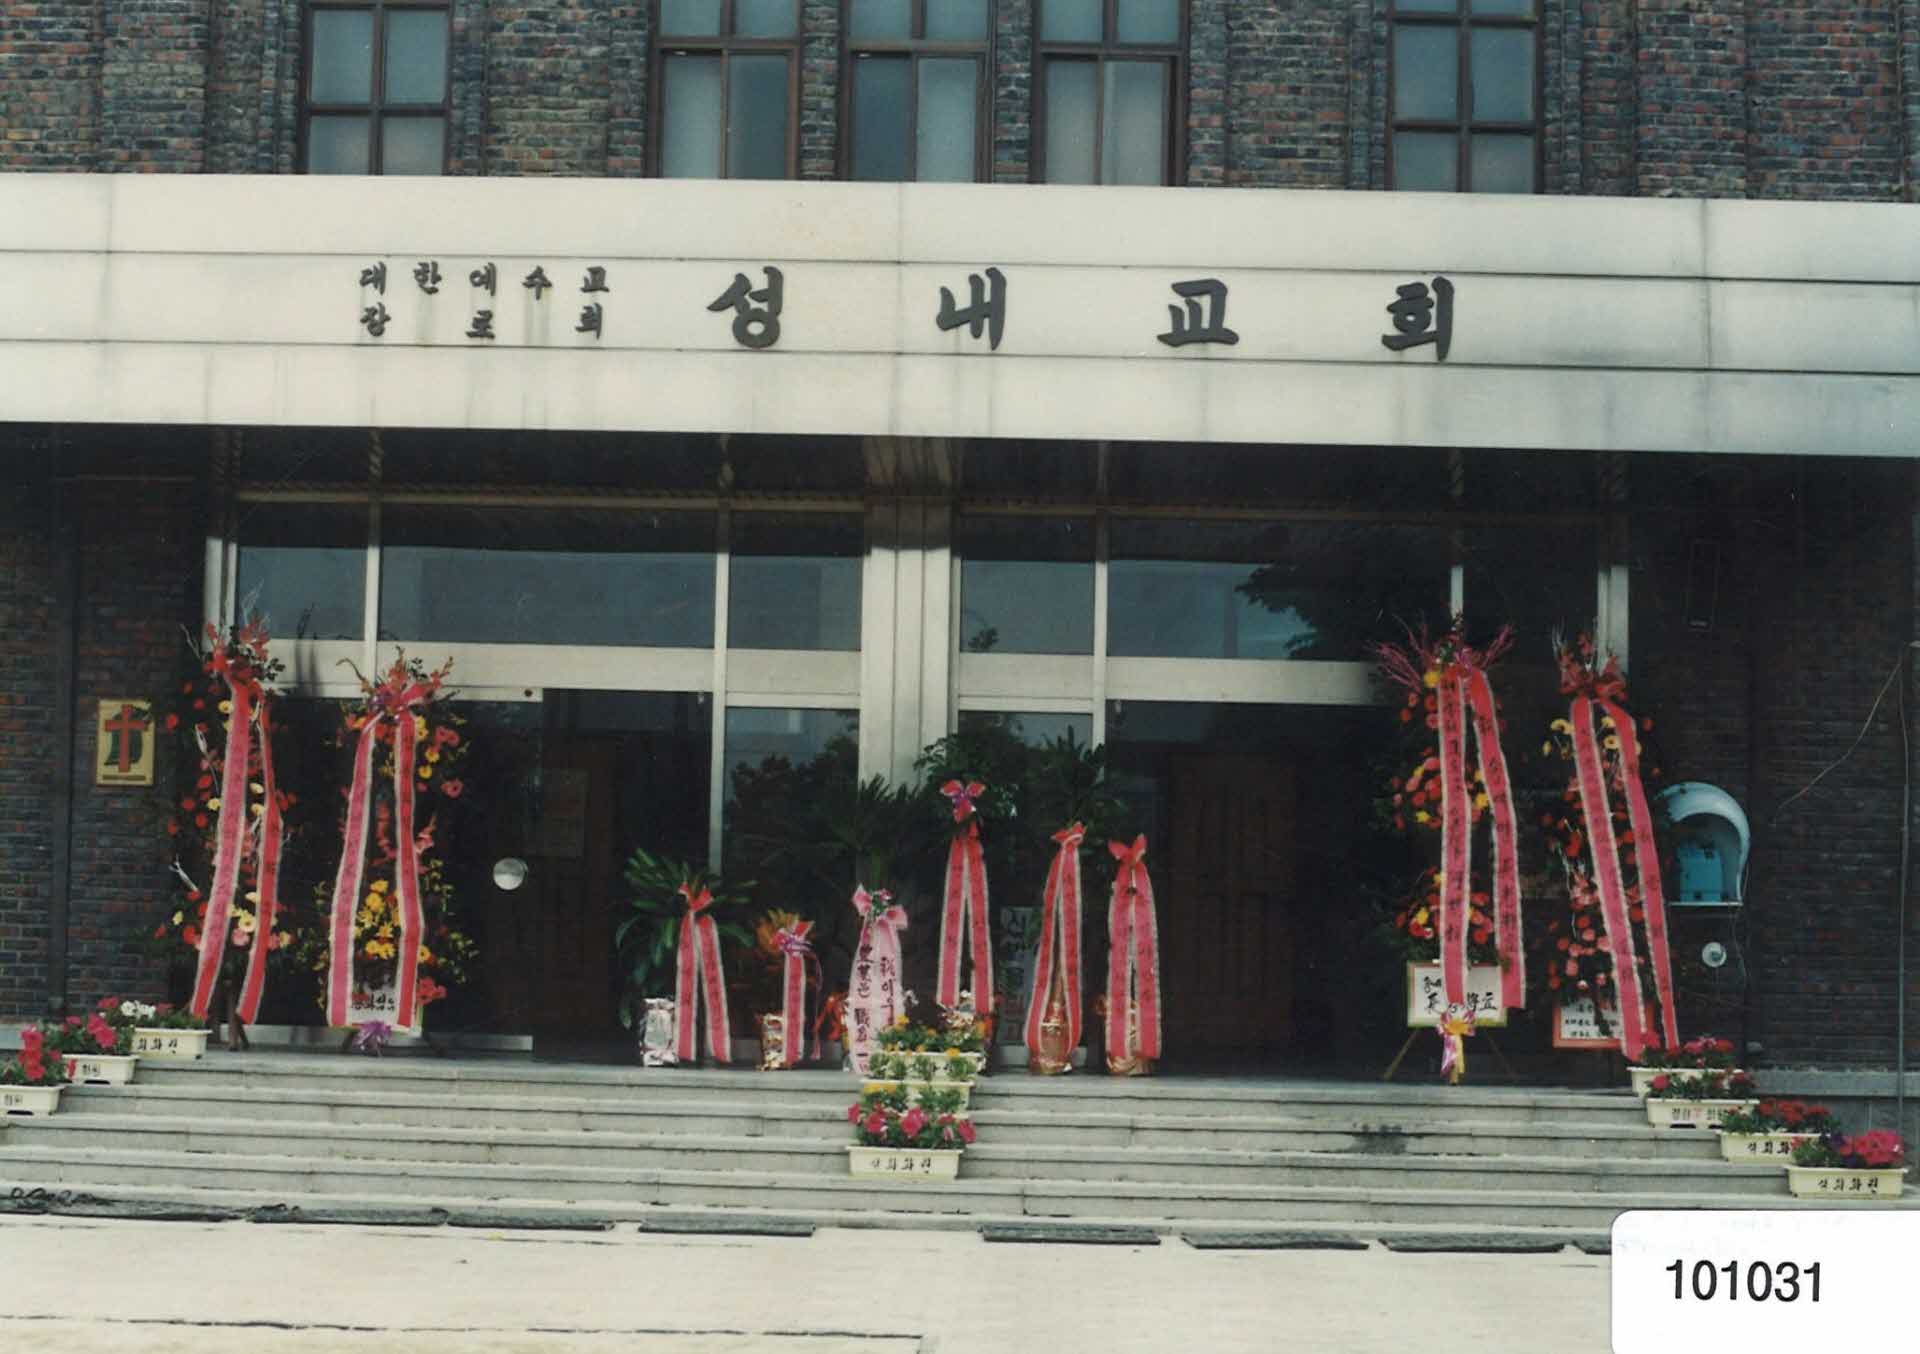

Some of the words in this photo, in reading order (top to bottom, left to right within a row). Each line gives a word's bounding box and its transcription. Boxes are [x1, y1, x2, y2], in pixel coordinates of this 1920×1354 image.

[360, 261, 610, 300] 대한예수교
[360, 302, 603, 340] 장로회
[706, 265, 1455, 362] 성내교회
